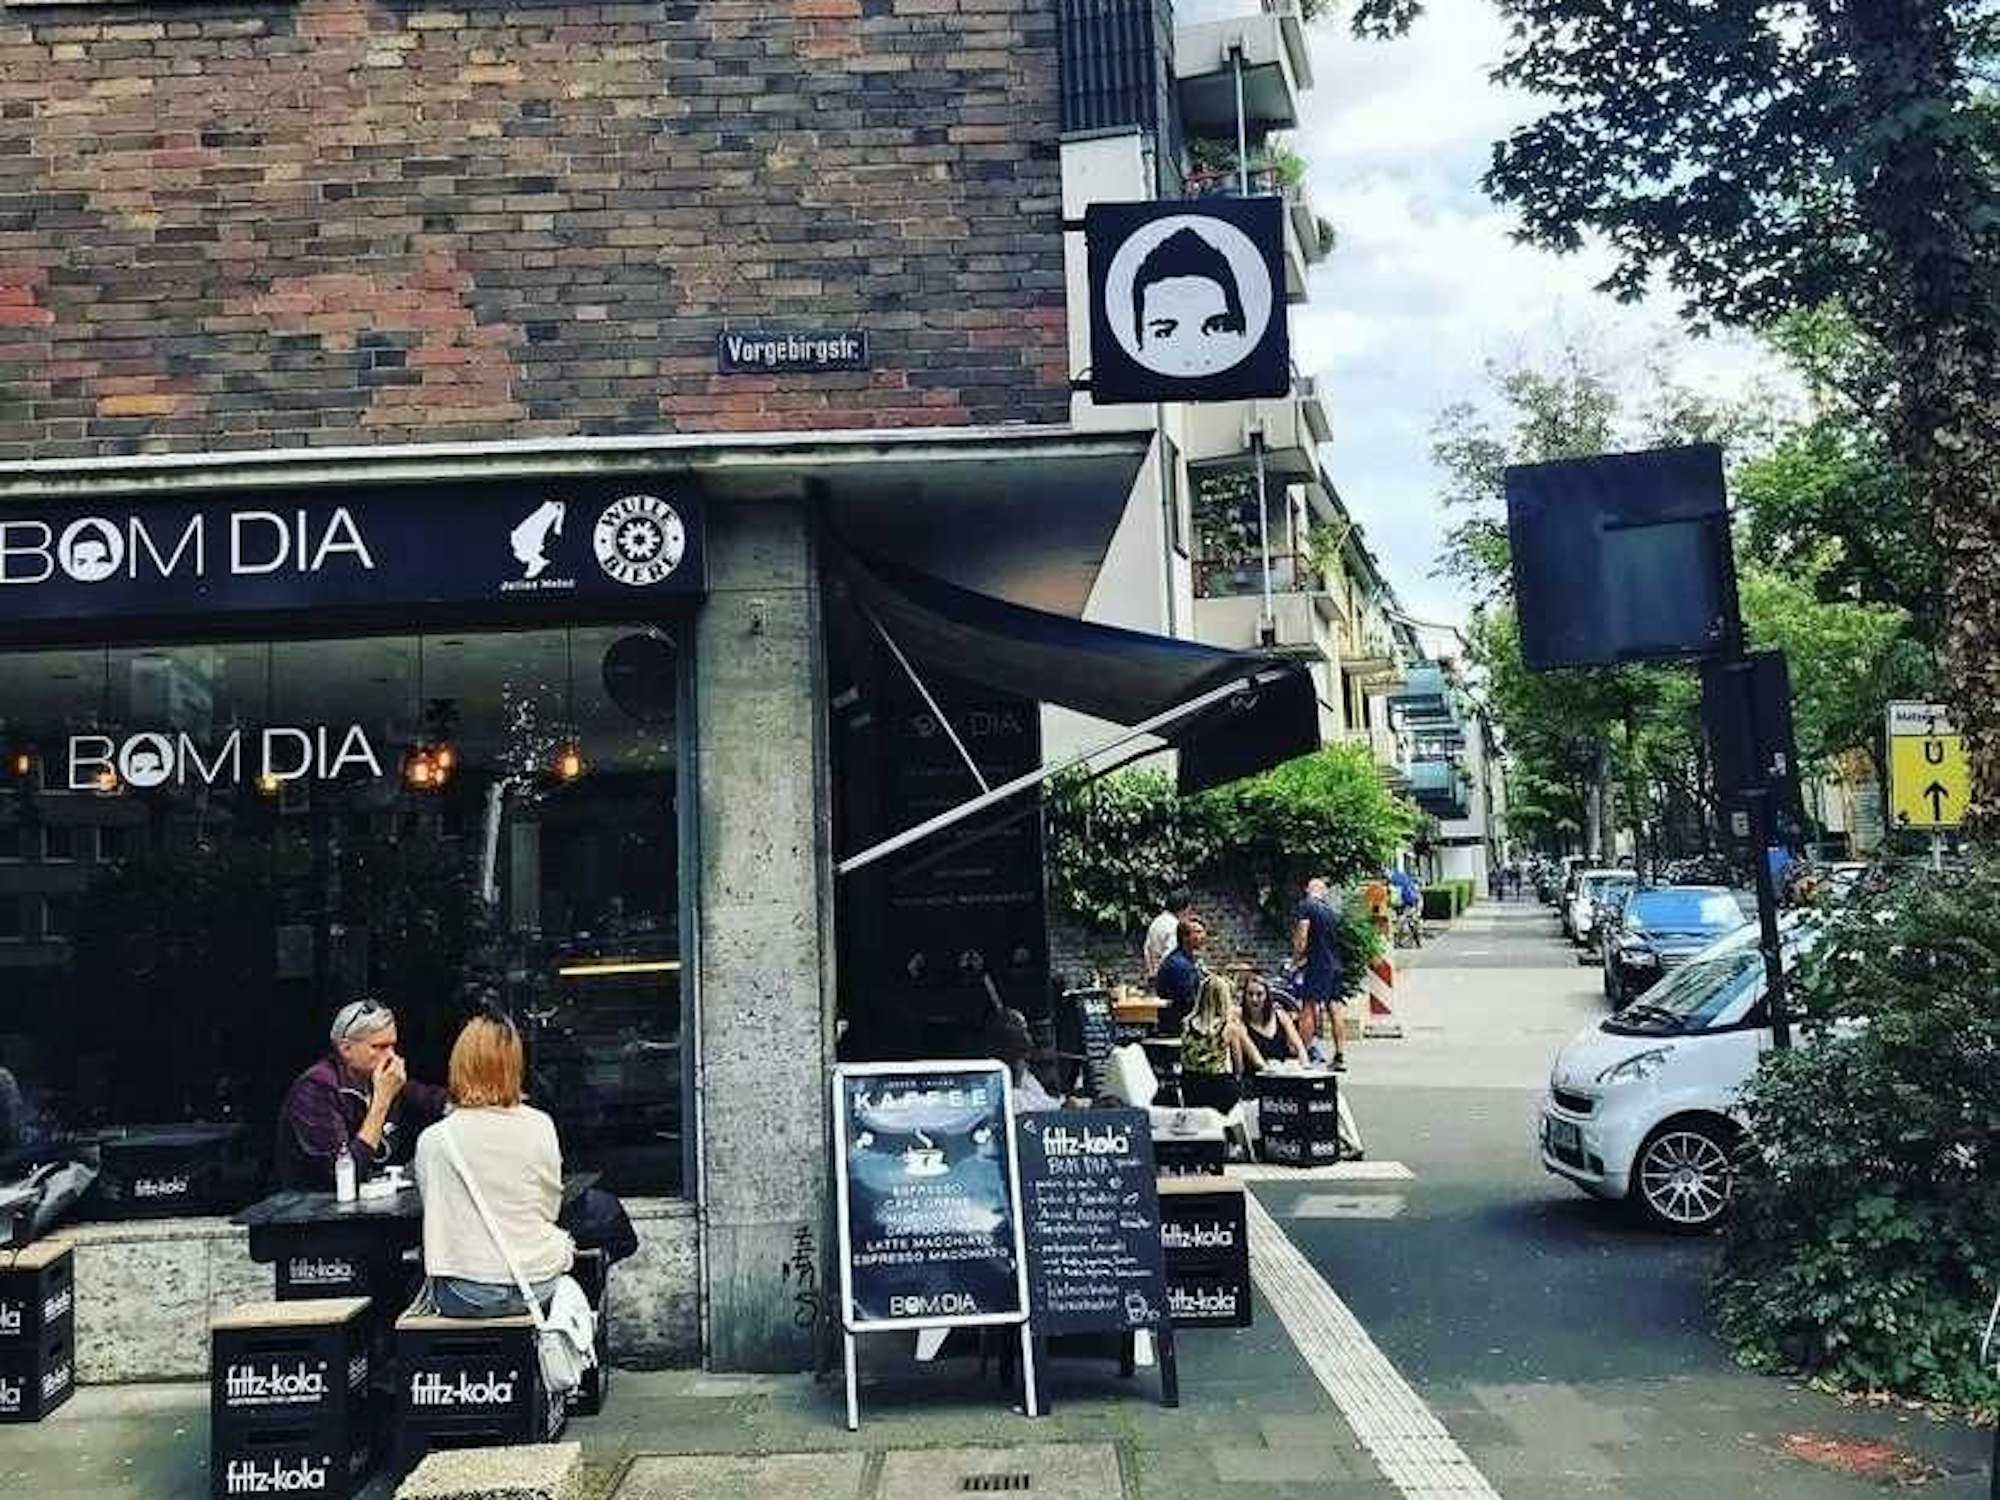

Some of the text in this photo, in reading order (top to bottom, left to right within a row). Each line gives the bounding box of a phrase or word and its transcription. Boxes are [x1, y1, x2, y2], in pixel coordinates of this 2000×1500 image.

[727, 333, 859, 366] Vorgebirgstr.
[0, 508, 375, 584] BOM DIA
[67, 725, 383, 790] BOM DIA
[1042, 1125, 1131, 1156] fritz-kola
[1160, 1221, 1235, 1248] fritz-kola
[288, 1257, 352, 1279] fritz-kola
[225, 1361, 324, 1398] fritz-kola
[410, 1370, 515, 1405] fritz-kola
[225, 1456, 327, 1494] fritz-kola
